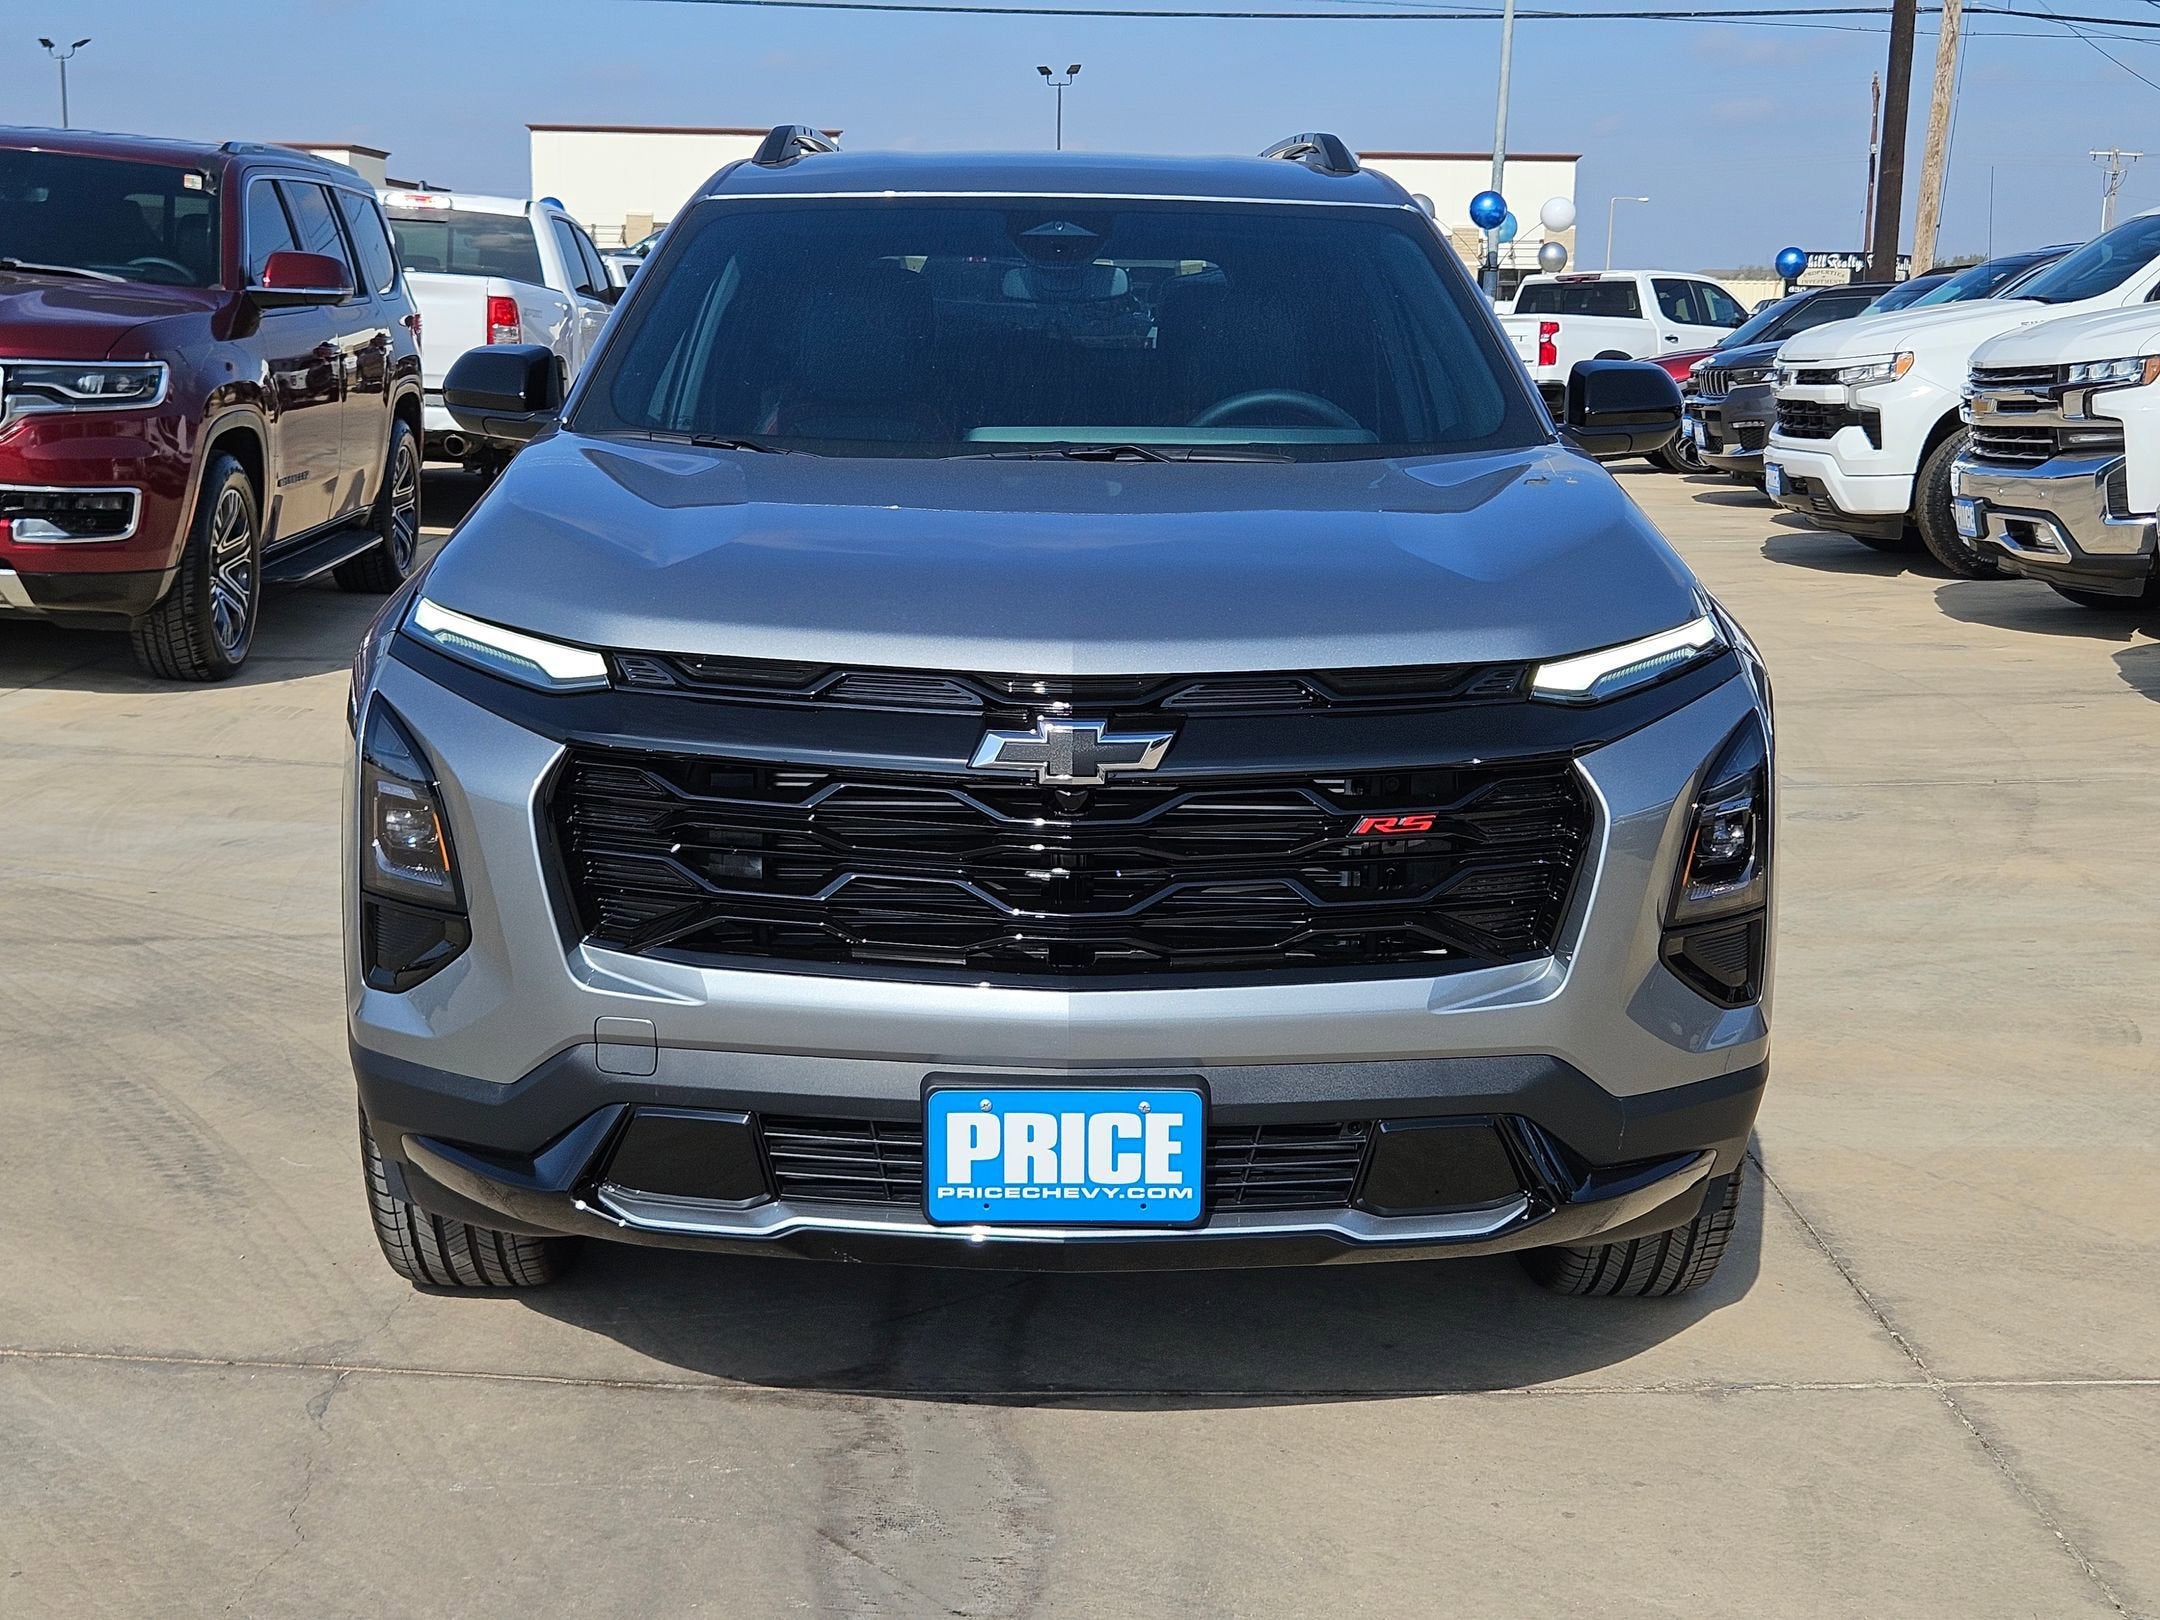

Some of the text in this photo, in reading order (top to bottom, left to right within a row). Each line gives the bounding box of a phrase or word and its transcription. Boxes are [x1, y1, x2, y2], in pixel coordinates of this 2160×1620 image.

[1352, 815, 1437, 834] RS
[946, 1112, 1183, 1184] PRICE
[937, 1186, 1193, 1199] PRICECHEVY.COM
